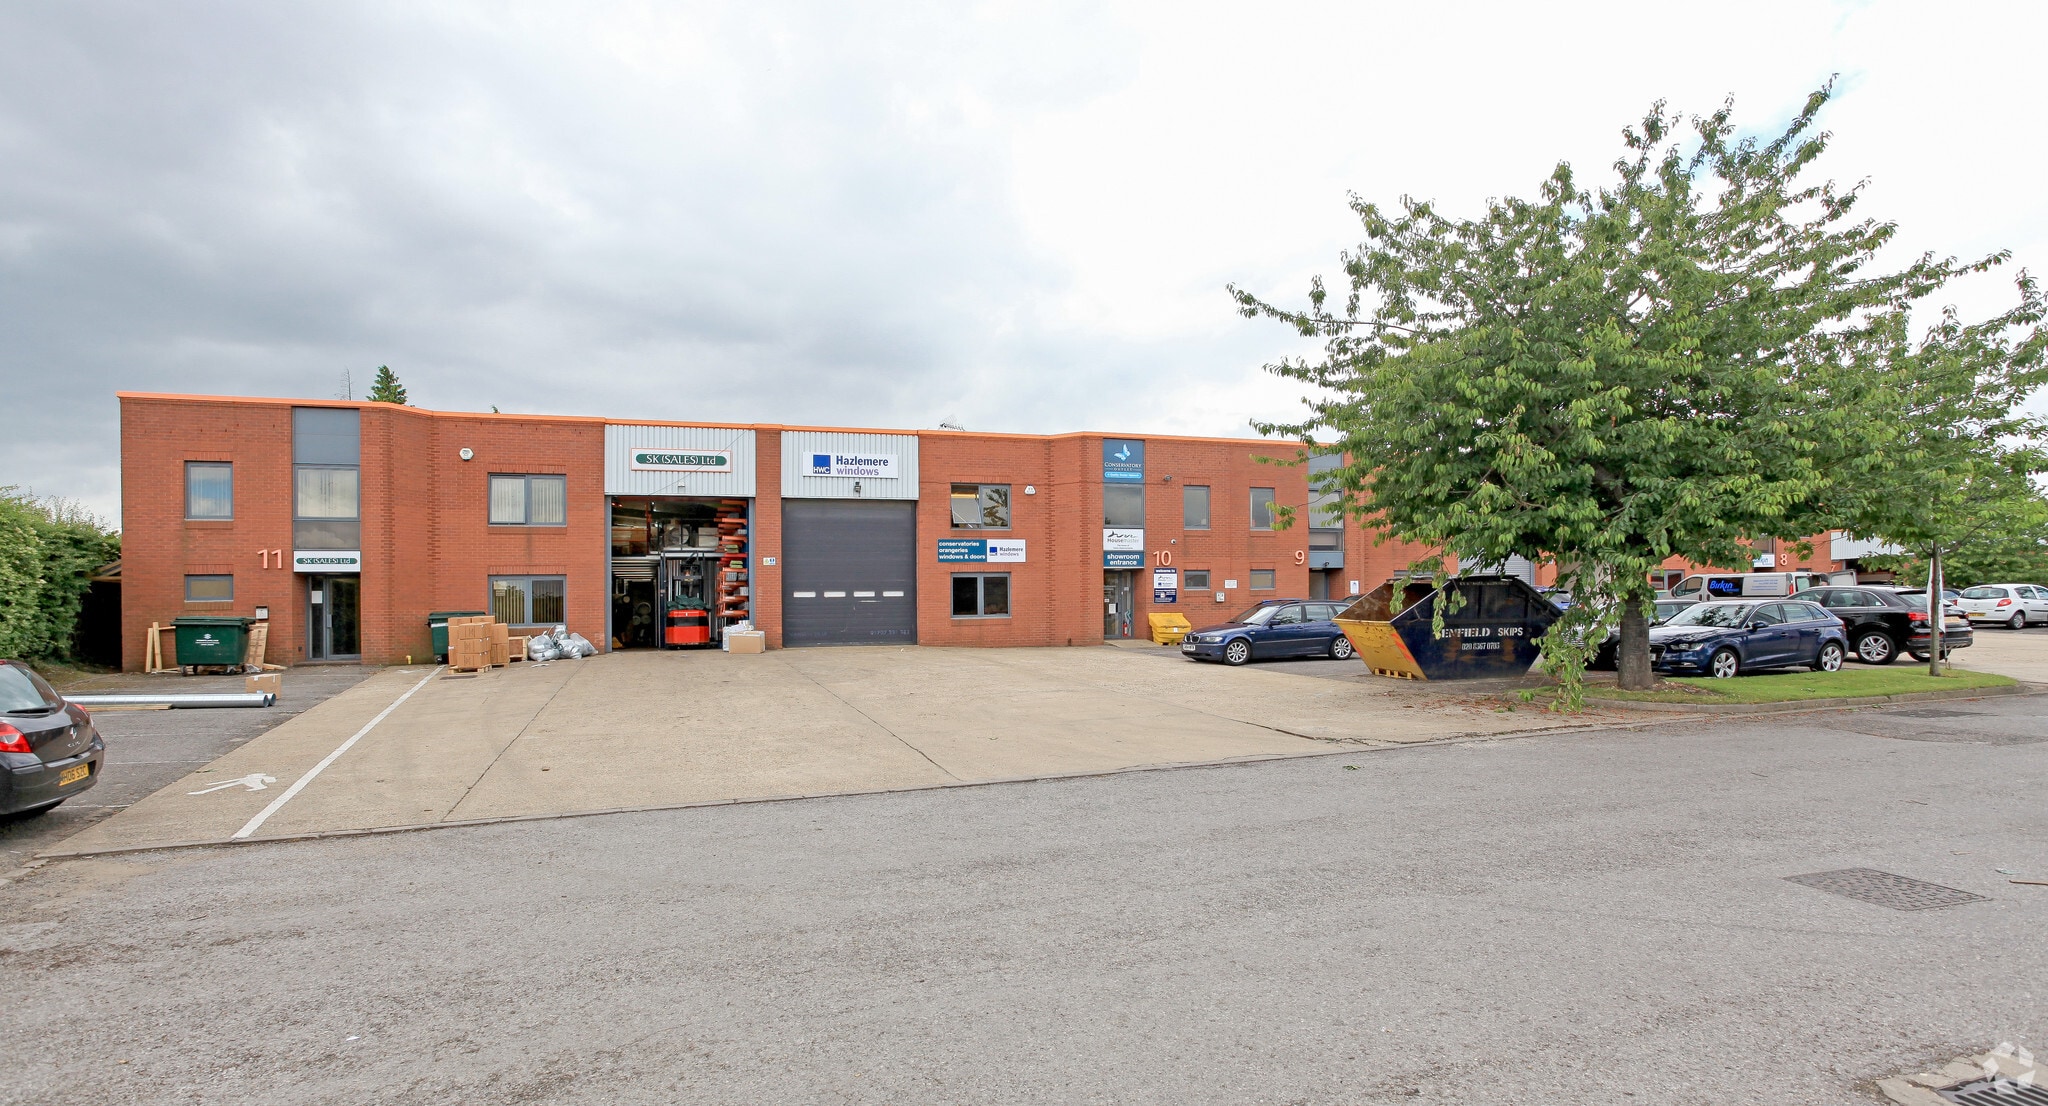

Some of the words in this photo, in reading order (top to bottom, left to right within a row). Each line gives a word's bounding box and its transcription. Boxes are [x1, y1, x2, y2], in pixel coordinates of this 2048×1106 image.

[646, 454, 659, 464] SK
[661, 455, 699, 465] (SALES)
[701, 456, 716, 465] Ltd
[836, 455, 889, 466] Hazlemere
[813, 466, 831, 474] HWC
[836, 466, 879, 476] windows
[257, 549, 283, 569] 11
[1153, 550, 1171, 566] 10
[1295, 550, 1305, 565] 9
[1780, 553, 1788, 566] 8
[1709, 580, 1733, 592] Birkin
[1441, 627, 1490, 638] ENFIELD
[1498, 627, 1523, 637] SKIPS
